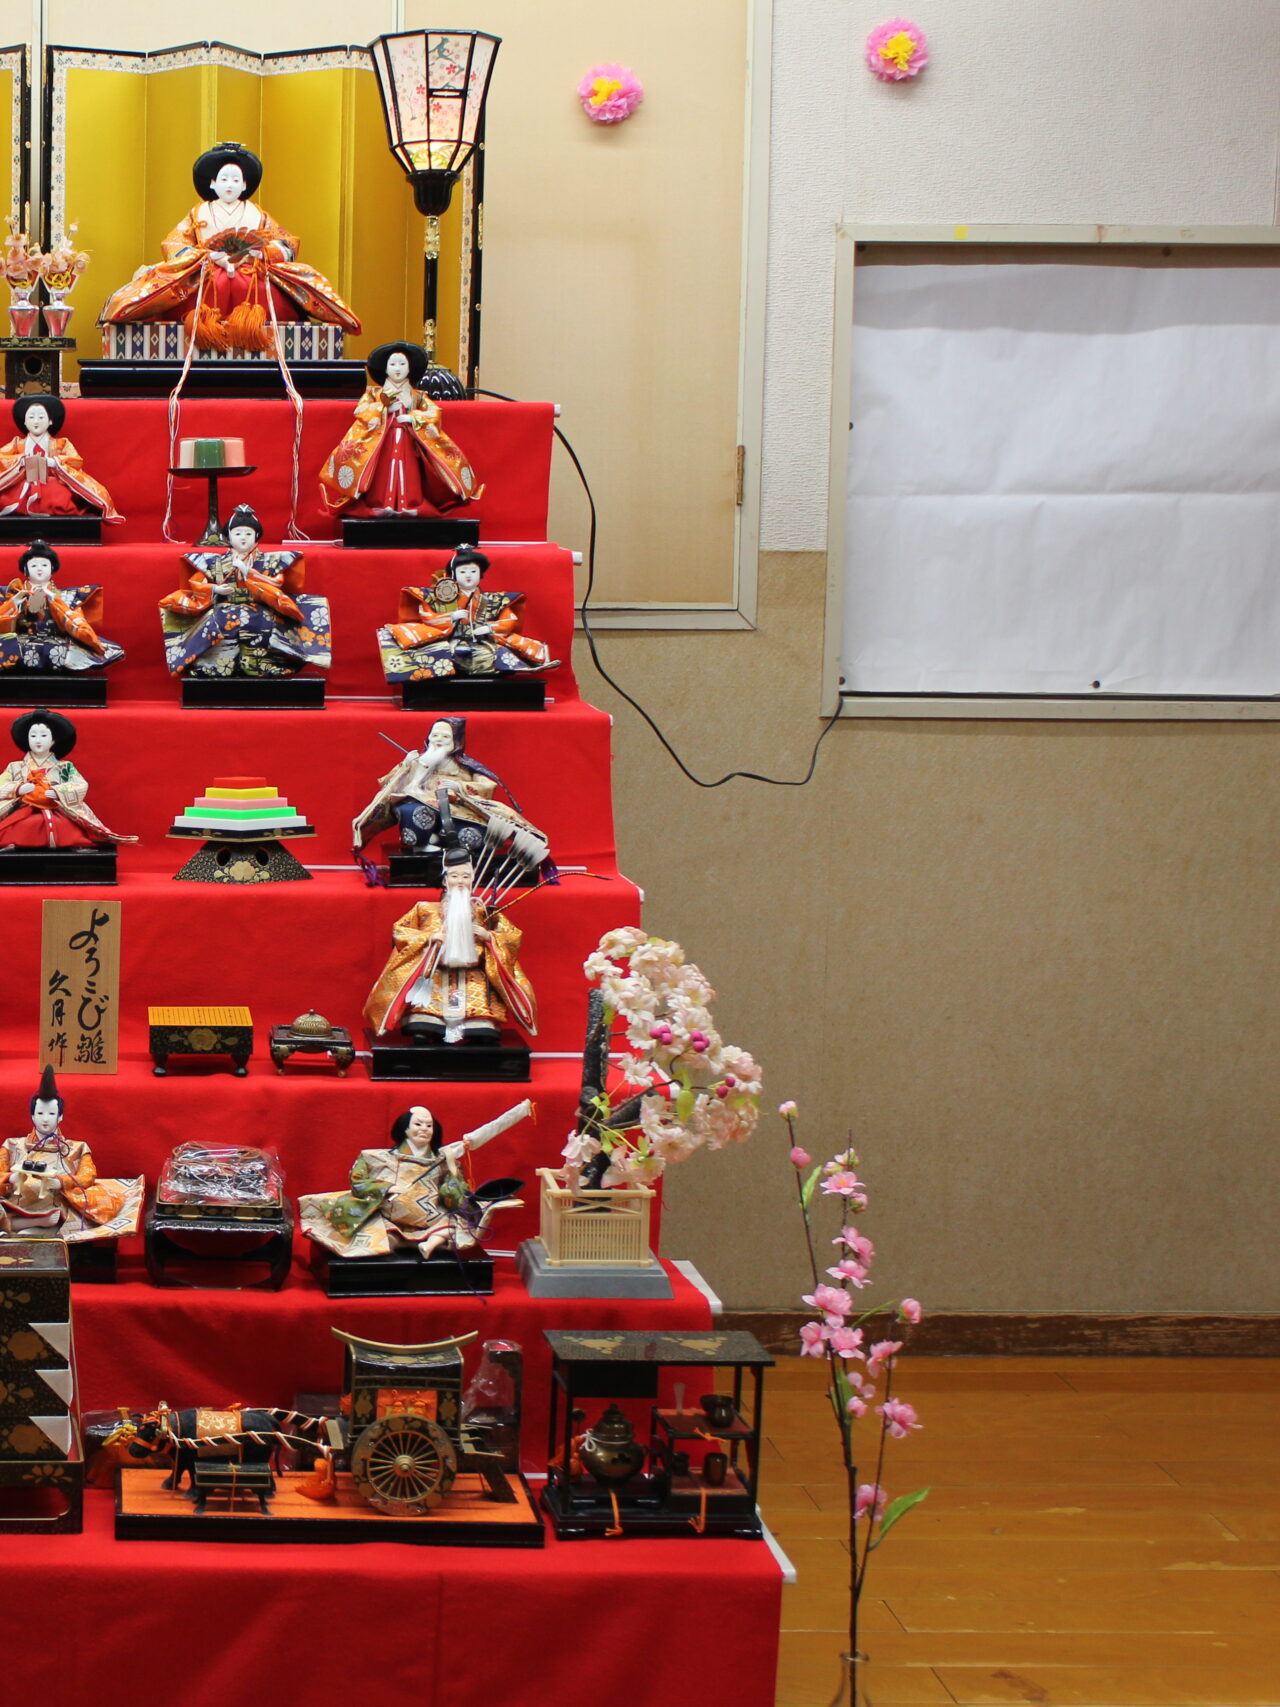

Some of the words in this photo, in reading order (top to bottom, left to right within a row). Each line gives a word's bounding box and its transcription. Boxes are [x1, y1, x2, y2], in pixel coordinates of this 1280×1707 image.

[69, 908, 110, 1064] よろこび雛
